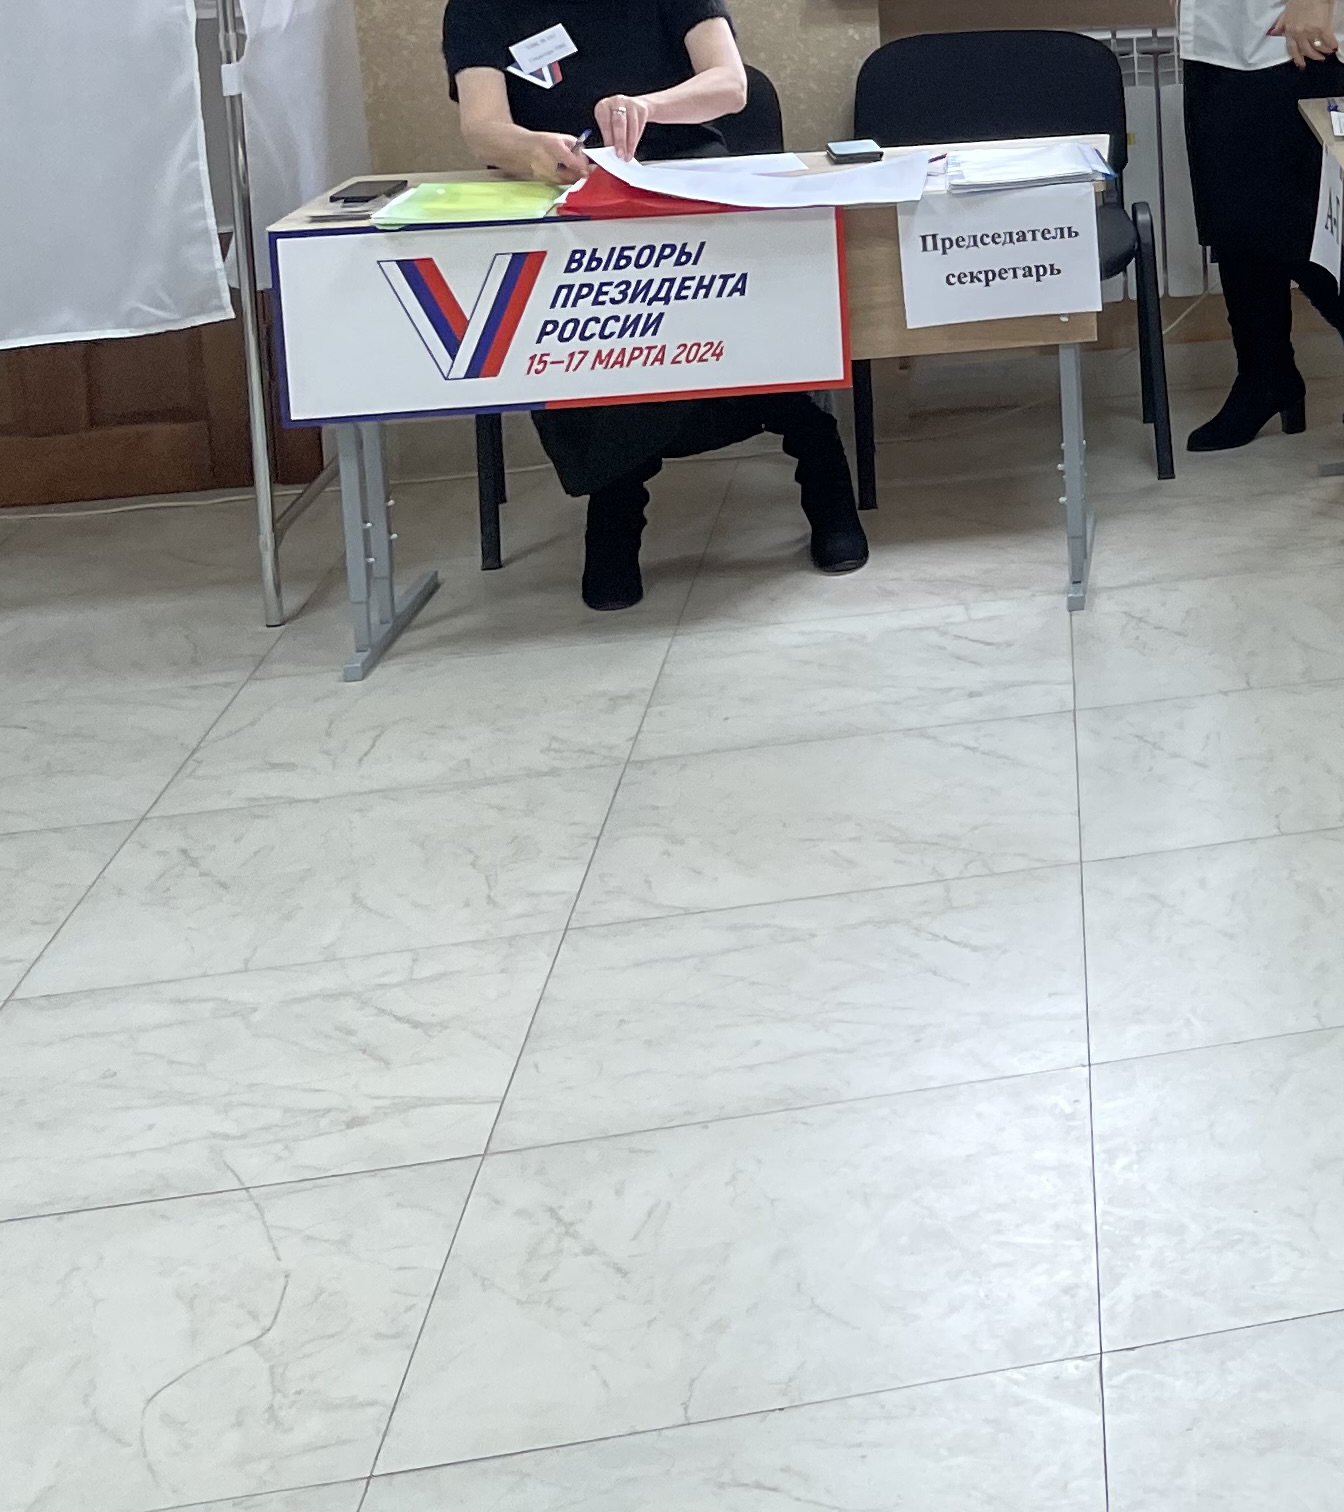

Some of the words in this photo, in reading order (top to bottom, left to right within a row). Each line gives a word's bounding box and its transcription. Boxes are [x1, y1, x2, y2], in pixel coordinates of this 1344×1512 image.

[919, 225, 1080, 255] Председатель
[563, 241, 706, 274] ВЫБОРЫ
[549, 272, 748, 310] ПРЕЗИДЕНТА
[945, 263, 1062, 288] секретарь
[536, 311, 665, 345] РОССИИ
[590, 344, 667, 371] МАРТА
[670, 340, 725, 365] 2024
